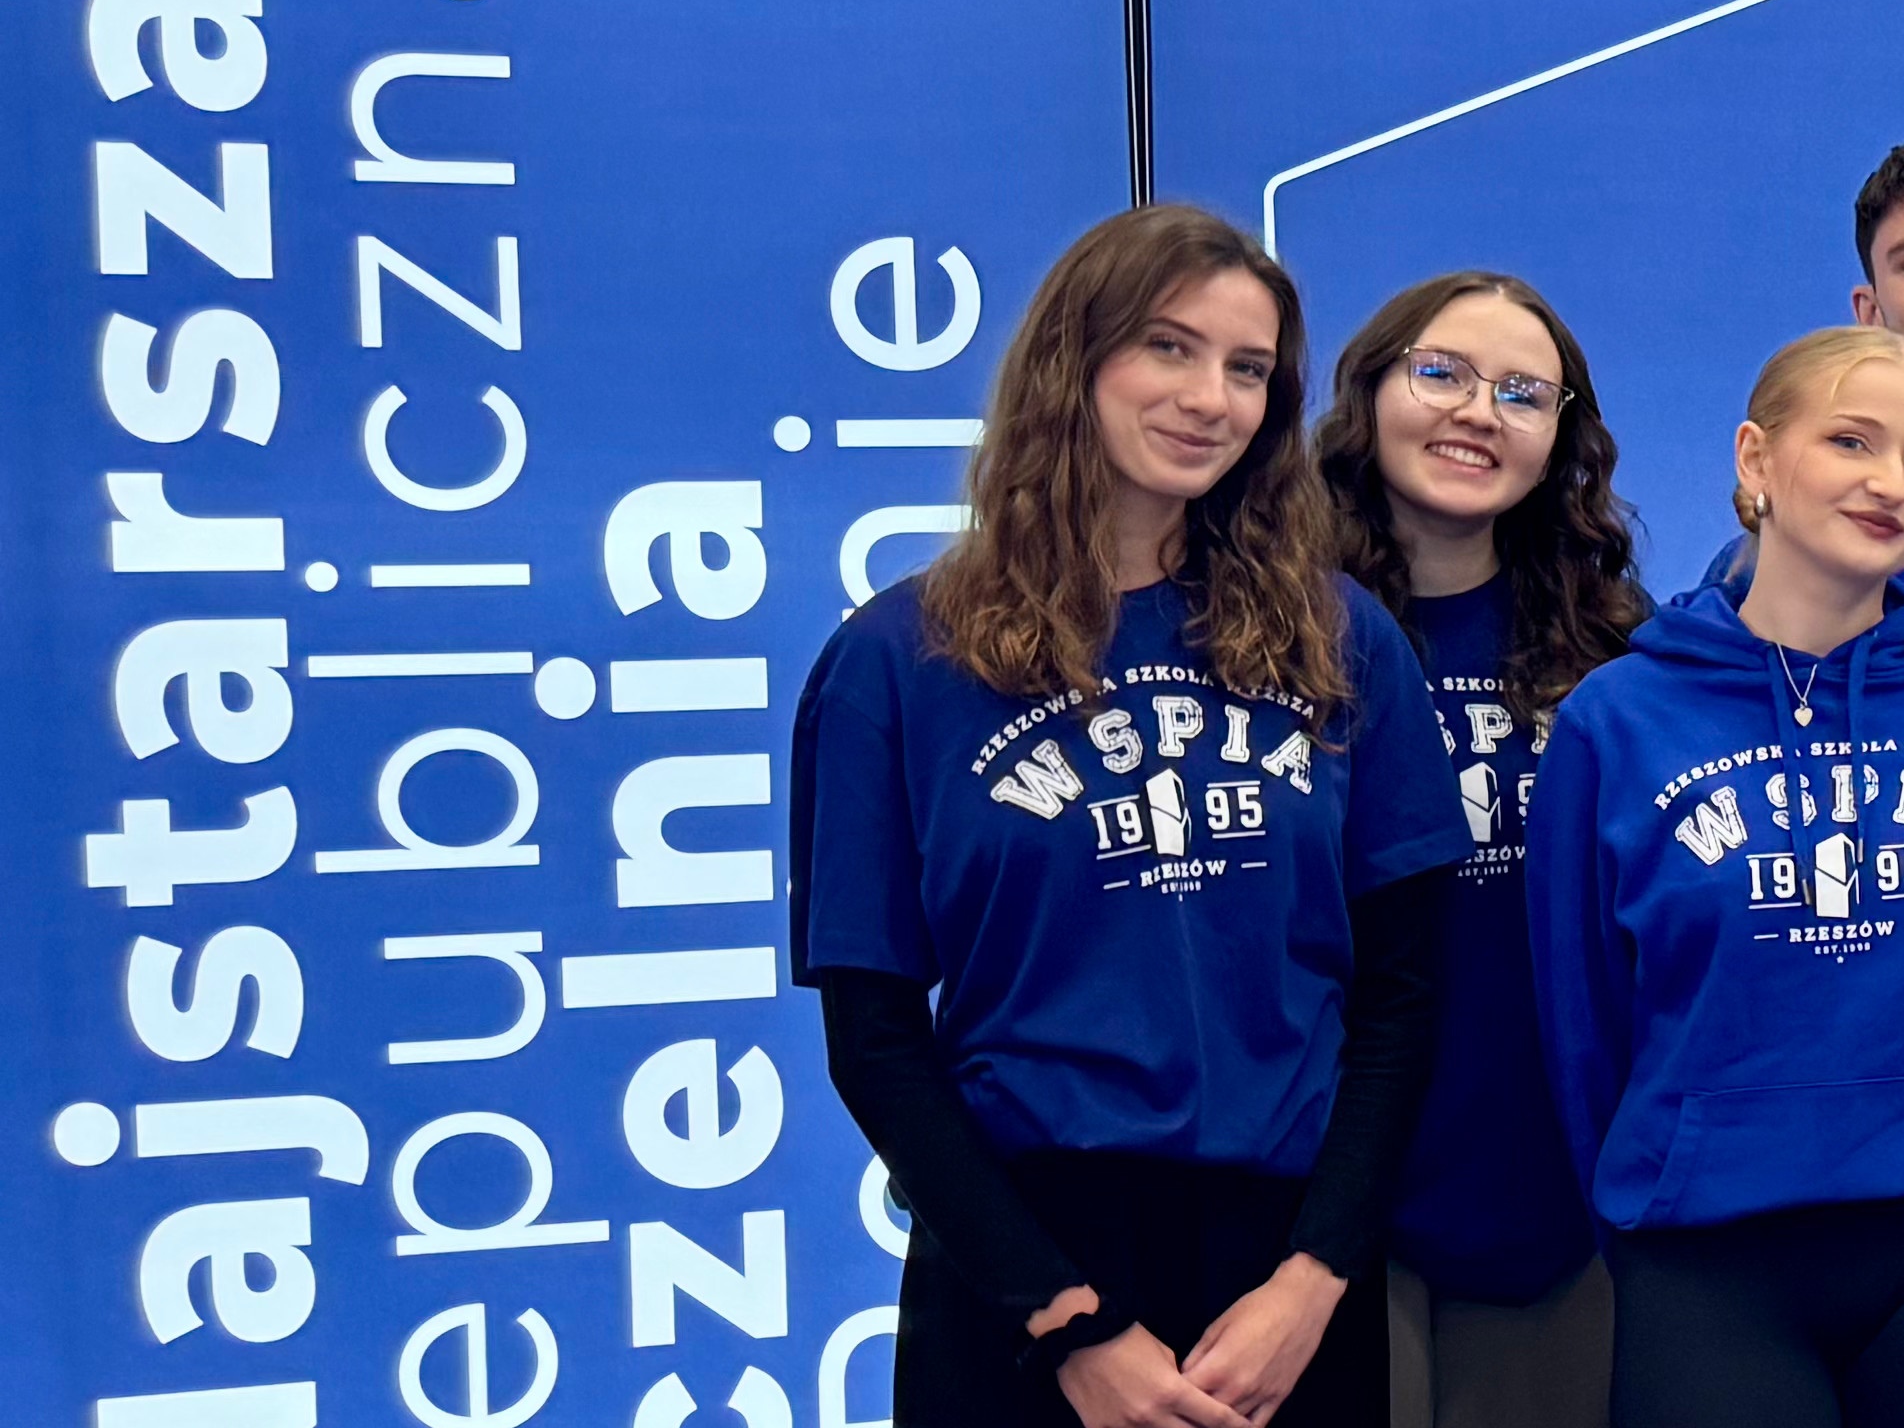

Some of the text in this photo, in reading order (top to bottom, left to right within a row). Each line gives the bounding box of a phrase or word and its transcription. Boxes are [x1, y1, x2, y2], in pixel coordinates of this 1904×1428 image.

[971, 676, 1118, 776] RZESZOWSA
[990, 695, 1313, 821] WSPIA
[1090, 786, 1264, 850] 19 95
[1749, 857, 1796, 901] 19
[1788, 921, 1895, 943] RZESZÓW
